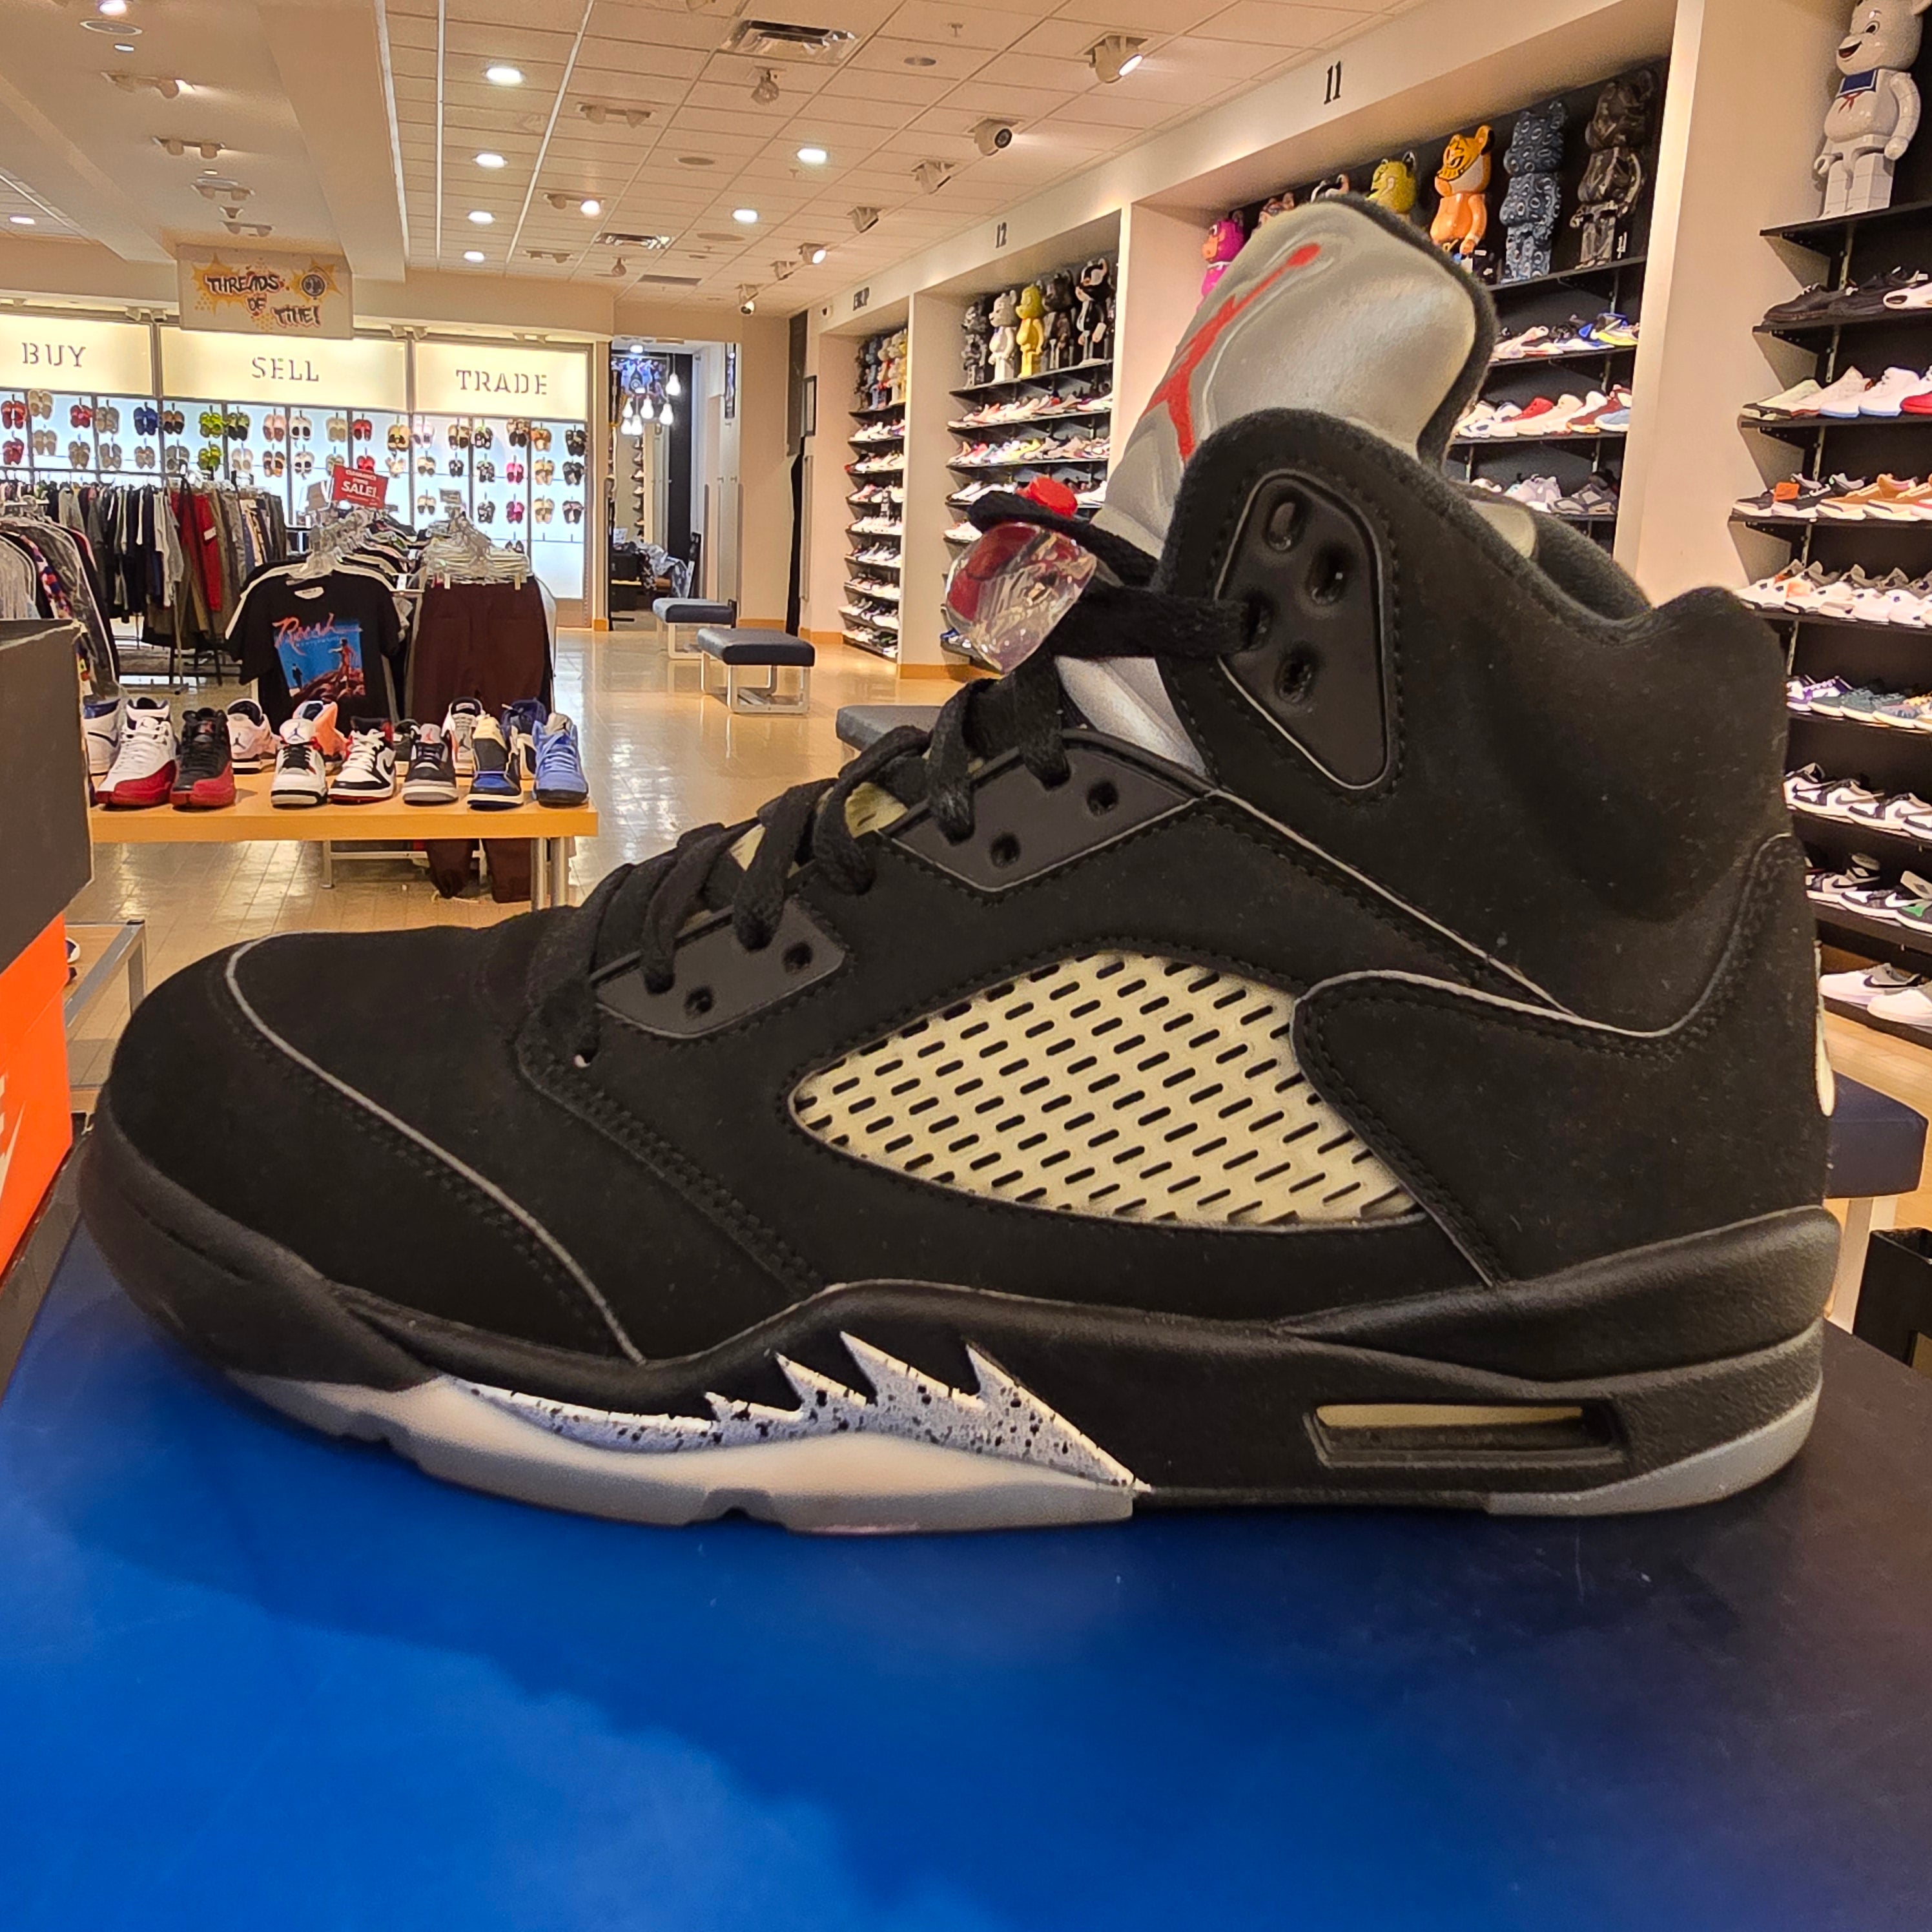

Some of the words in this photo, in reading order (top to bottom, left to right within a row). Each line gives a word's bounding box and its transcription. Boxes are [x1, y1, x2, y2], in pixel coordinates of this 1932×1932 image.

[1323, 60, 1342, 105] 11
[995, 221, 1007, 249] 12
[205, 274, 281, 294] THREADS
[247, 294, 266, 311] OF
[21, 342, 87, 368] BUY
[251, 356, 319, 382] SELL
[456, 369, 548, 395] TRADE
[341, 480, 377, 498] SALE!
